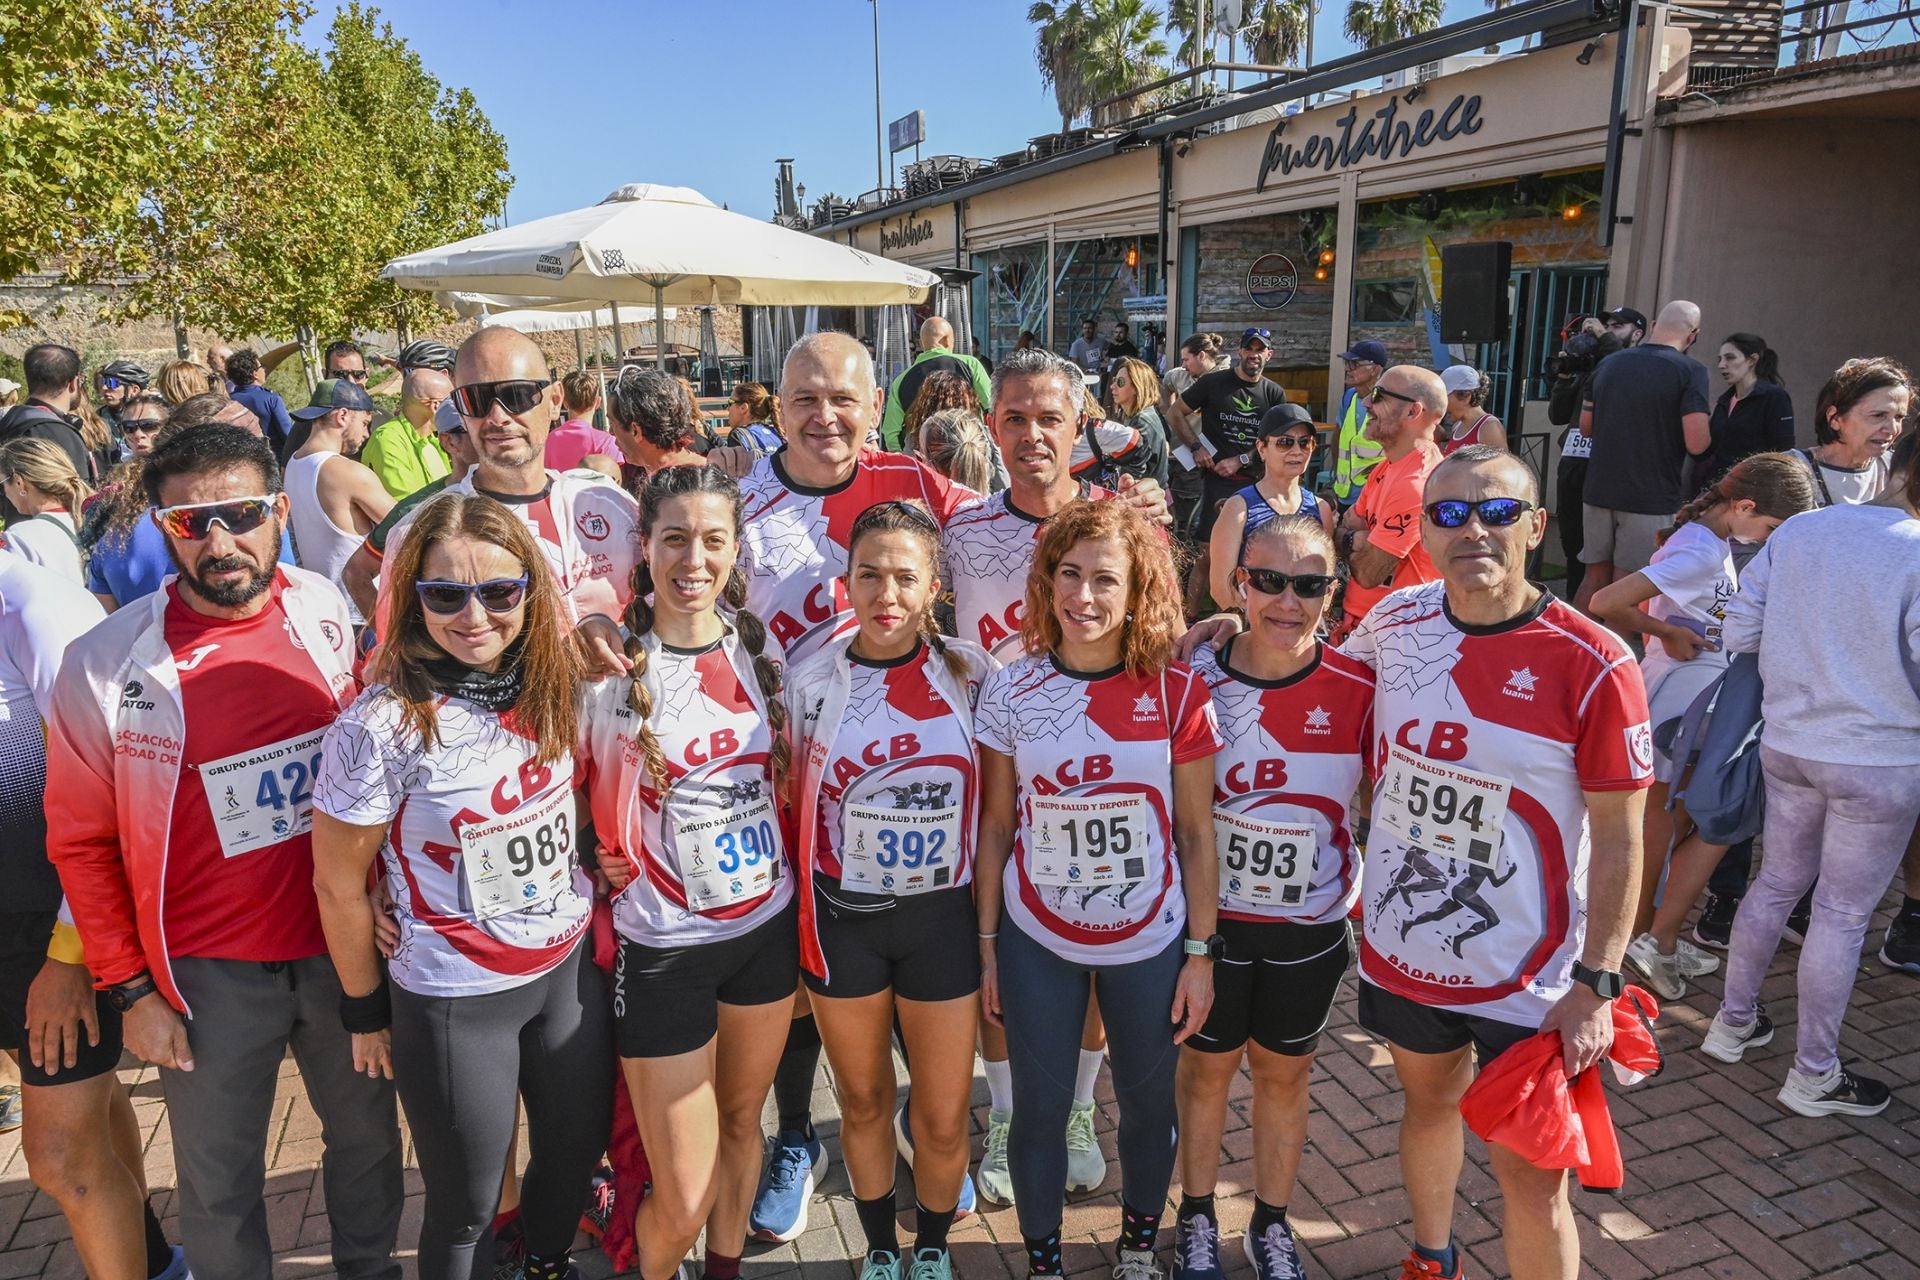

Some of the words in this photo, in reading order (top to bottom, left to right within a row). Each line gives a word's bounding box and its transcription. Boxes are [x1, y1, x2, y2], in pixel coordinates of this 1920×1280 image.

[1250, 275, 1295, 288] PEPSI
[1502, 687, 1534, 701] luanvi
[1133, 714, 1159, 722] luanvi
[1303, 727, 1331, 735] luanvi
[160, 753, 178, 766] DE
[208, 760, 247, 776] GRUPO
[249, 750, 284, 766] SALUD
[285, 746, 293, 754] Y
[1391, 750, 1416, 767] GRUPO
[1416, 762, 1446, 777] SALUD
[1448, 770, 1456, 779] Y
[1456, 773, 1503, 793] DEPORTE
[851, 810, 879, 821] GRUPO
[881, 815, 910, 823] SALUD
[912, 816, 919, 824] Y
[920, 812, 954, 824] DEPORTE
[1035, 801, 1060, 811] GRUPO
[1061, 803, 1090, 811] SALUD
[1091, 803, 1097, 811] Y
[1100, 799, 1140, 809] DEPORTE
[1407, 775, 1484, 833] 594
[467, 825, 504, 841] GRUPO
[506, 813, 538, 831] SALUD
[539, 809, 545, 817] Y
[681, 822, 712, 834] GRUPO
[714, 813, 742, 827] SALUD
[742, 811, 748, 819] Y
[1235, 819, 1263, 832] SALUD
[1273, 828, 1311, 837] DEPORTE
[506, 812, 570, 878] 983
[715, 820, 776, 874] 390
[876, 828, 946, 869] 392
[1061, 815, 1131, 858] 195
[1226, 833, 1298, 879] 593
[1072, 918, 1133, 931] BADAJOZ
[1387, 953, 1474, 985] BADAJOZ
